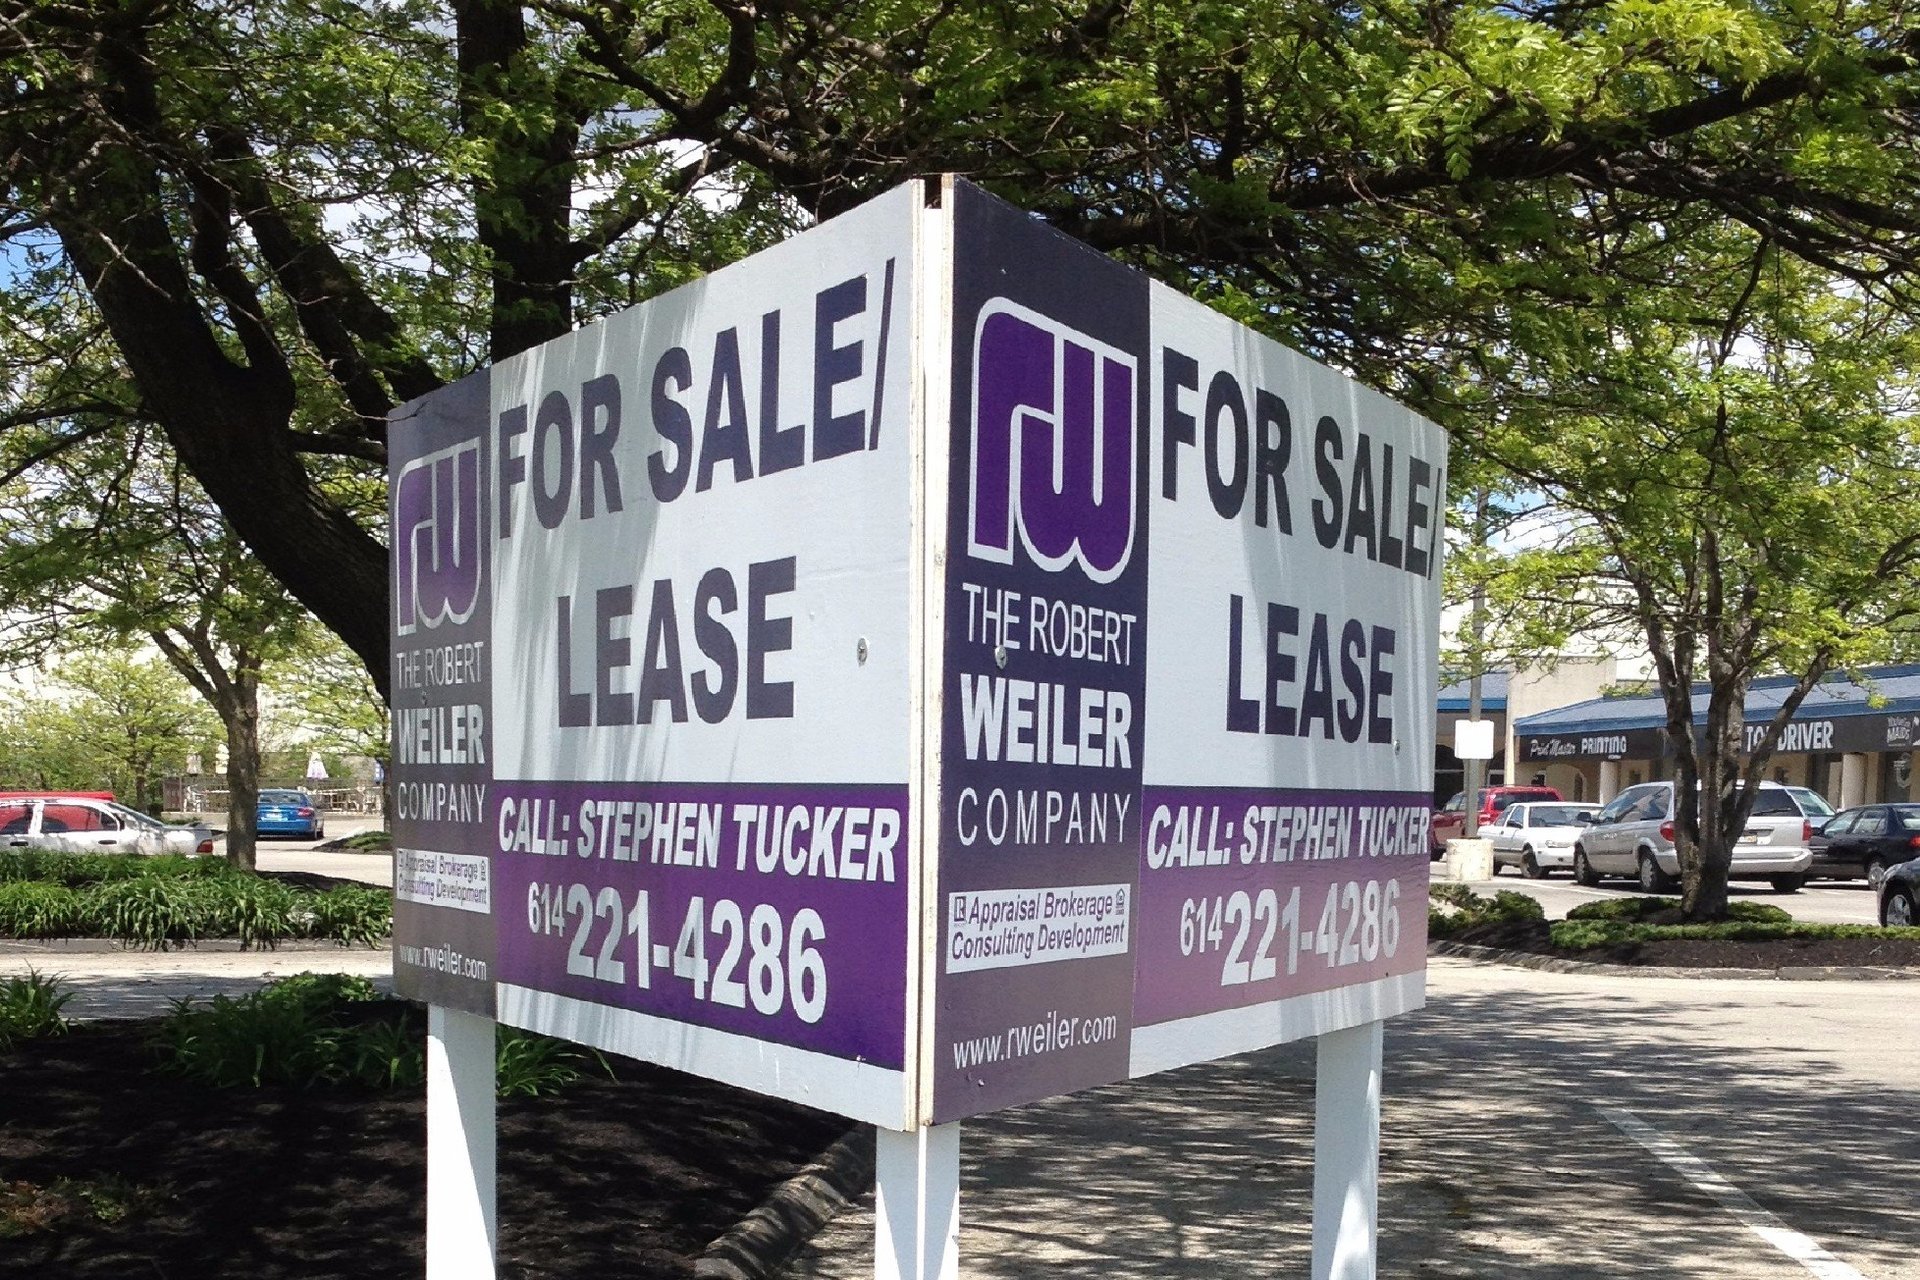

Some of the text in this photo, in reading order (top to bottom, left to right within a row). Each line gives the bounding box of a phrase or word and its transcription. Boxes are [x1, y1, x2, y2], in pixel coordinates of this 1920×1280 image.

[500, 257, 895, 539] FOR SALE/
[1162, 346, 1443, 581] FOR SALE/
[558, 555, 796, 728] LEASE
[962, 582, 1137, 666] THE ROBERT
[397, 641, 484, 689] THE ROBERT
[1226, 594, 1396, 744] LEASE
[397, 704, 485, 764] WEILER
[960, 673, 1132, 768] WEILER
[1581, 735, 1627, 754] PRINTING
[1776, 721, 1834, 751] DRIVER
[397, 782, 485, 823] COMPANY
[957, 787, 1131, 846] COMPANY
[499, 796, 900, 882] CALL: STEPHEN TUCKER
[1147, 804, 1430, 869] CALL: STEPHEN TUCKER
[437, 878, 486, 906] Development
[440, 855, 477, 883] Brokerage
[952, 919, 1125, 959] Consulting Development
[969, 892, 1041, 931] Appraisal
[1044, 890, 1113, 921] Brokerage
[400, 943, 487, 981] www.rweiler.com
[953, 1010, 1117, 1070] www.rweiler.com
